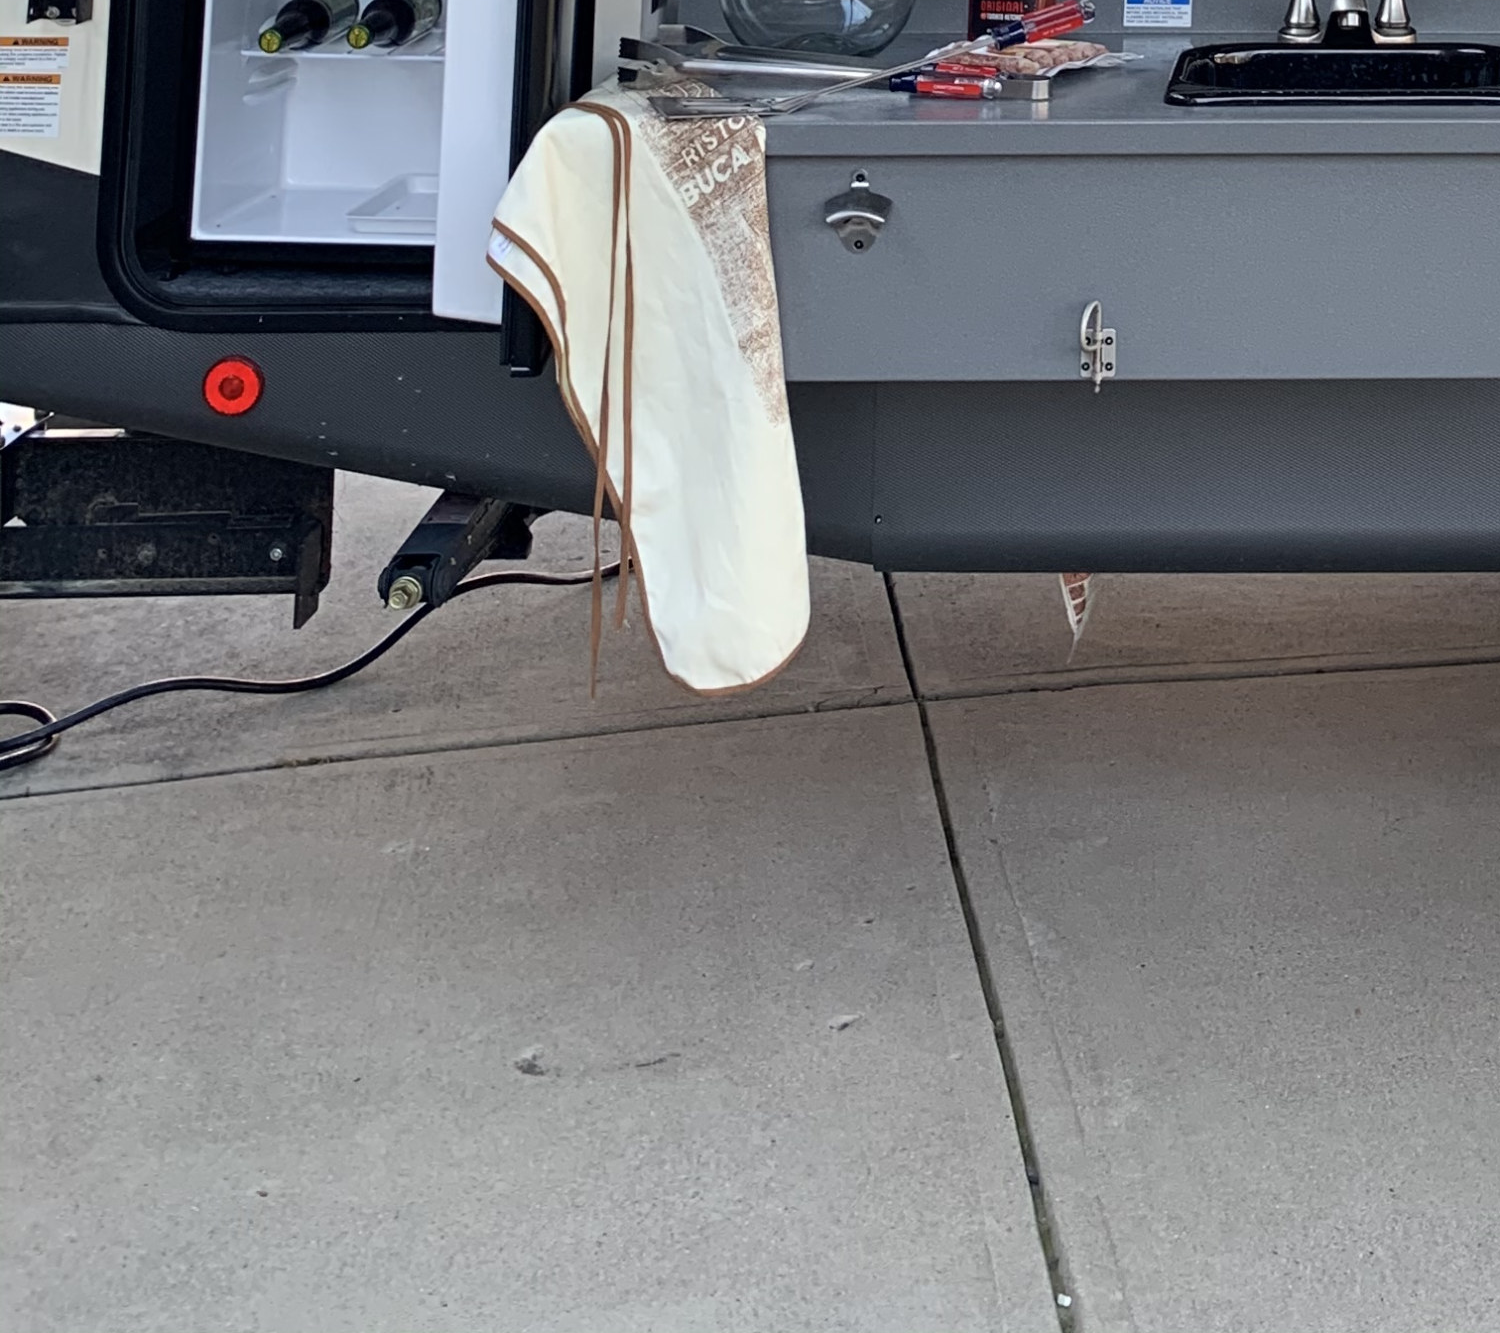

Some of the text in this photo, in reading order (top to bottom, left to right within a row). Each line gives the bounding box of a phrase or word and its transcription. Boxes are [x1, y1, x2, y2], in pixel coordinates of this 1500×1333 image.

[980, 0, 1024, 13] ORIGINAL
[21, 37, 59, 46] WARNING
[12, 75, 53, 83] WARNING
[679, 143, 753, 208] BUCA
